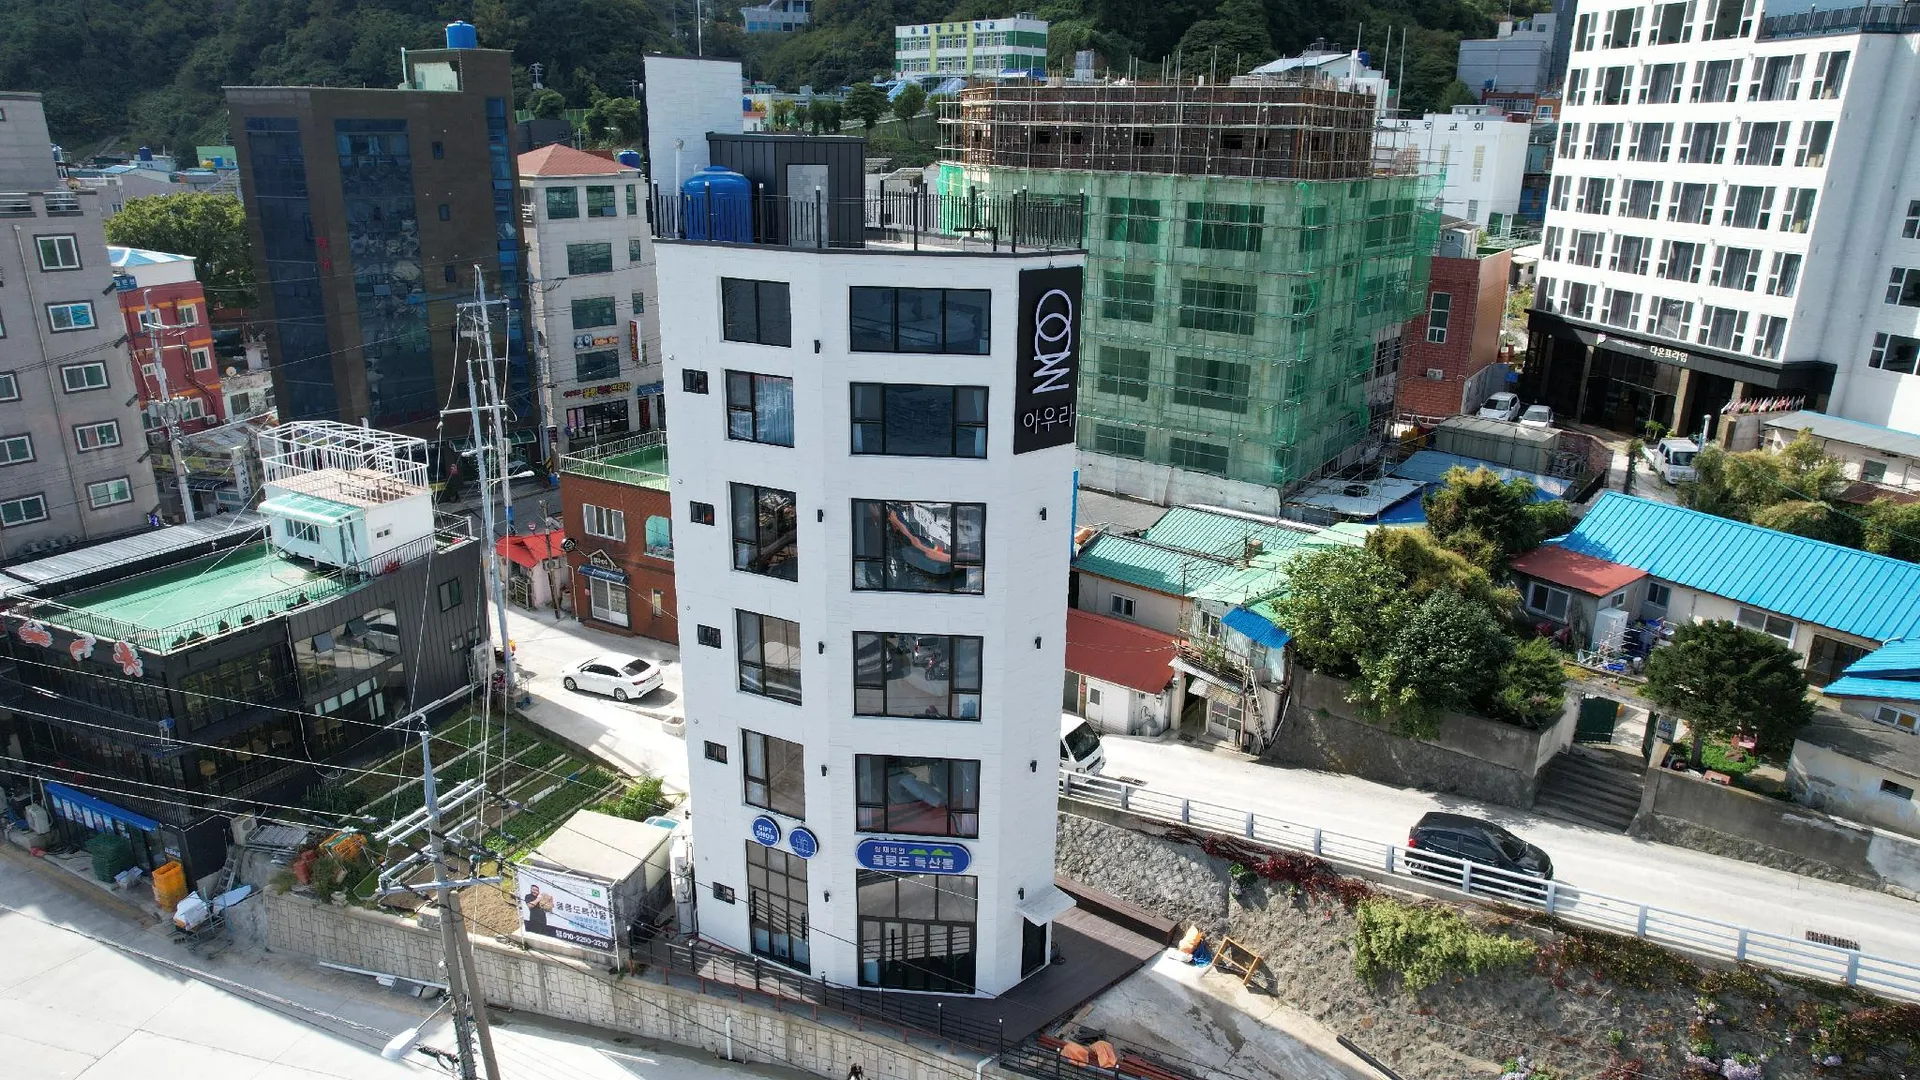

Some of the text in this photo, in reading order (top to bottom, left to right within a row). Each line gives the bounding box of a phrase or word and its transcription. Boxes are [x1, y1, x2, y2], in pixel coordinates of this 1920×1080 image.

[1649, 345, 1688, 363] 다온프라임
[1023, 403, 1074, 435] 아우라
[756, 831, 775, 840] SHOP
[757, 824, 773, 833] GIFT
[872, 854, 954, 870] 울릉도 특산물
